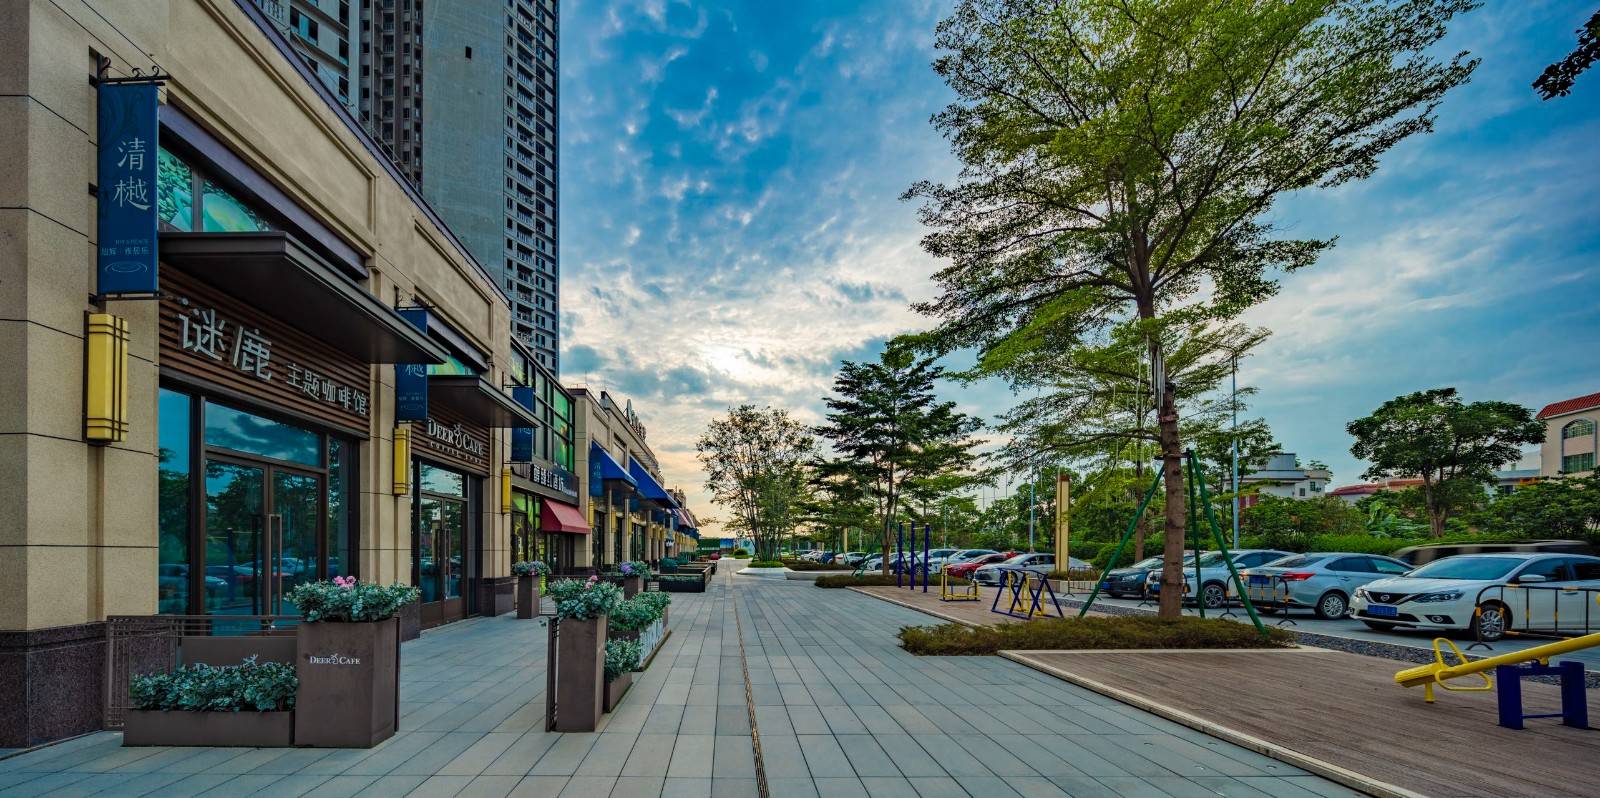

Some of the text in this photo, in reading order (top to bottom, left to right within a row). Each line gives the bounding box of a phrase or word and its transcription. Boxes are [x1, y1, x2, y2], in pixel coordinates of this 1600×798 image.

[178, 297, 368, 416] 谜鹿 主题咖啡馆
[427, 417, 454, 444] DEER
[309, 655, 361, 665] DEER CAFE
